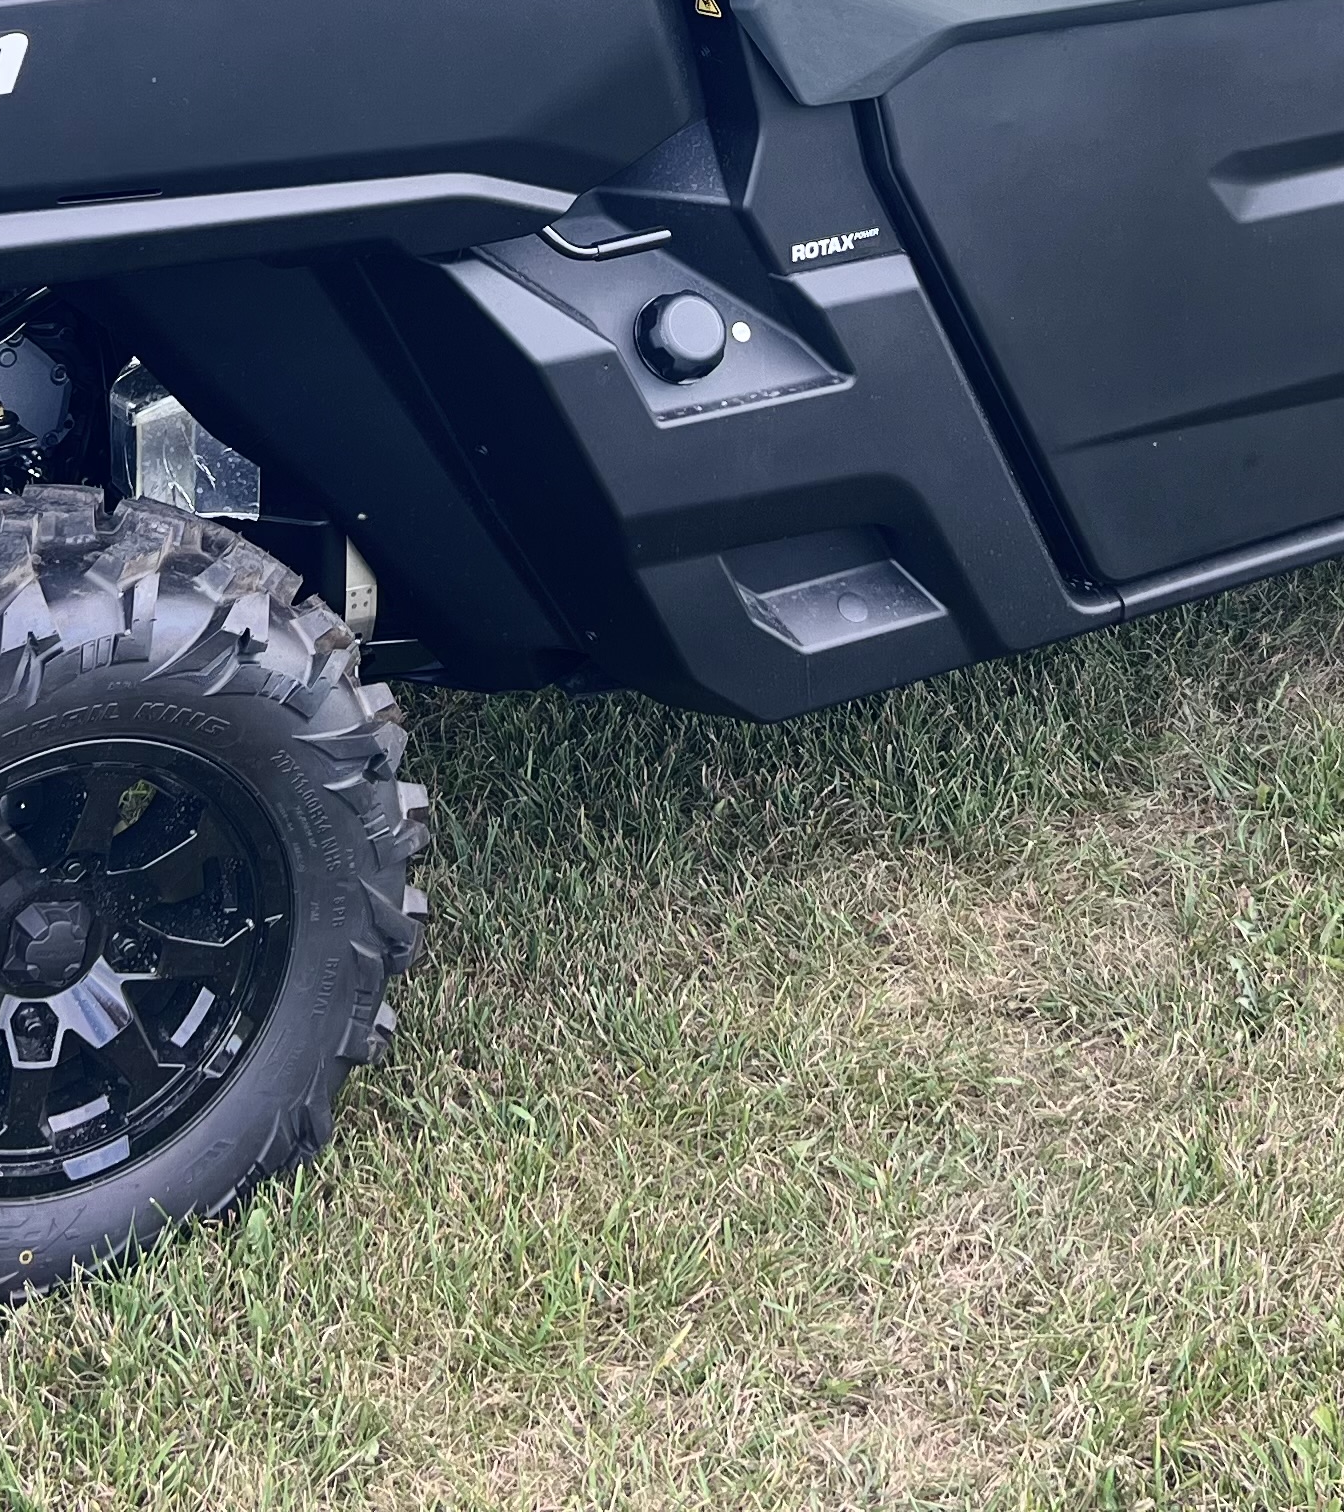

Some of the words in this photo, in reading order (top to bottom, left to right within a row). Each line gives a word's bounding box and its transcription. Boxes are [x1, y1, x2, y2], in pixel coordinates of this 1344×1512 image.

[791, 233, 855, 262] ROTAX
[853, 228, 880, 241] POWER
[1, 702, 120, 746] TRAIL
[133, 702, 232, 735] KING
[311, 957, 341, 1019] RADIAL
